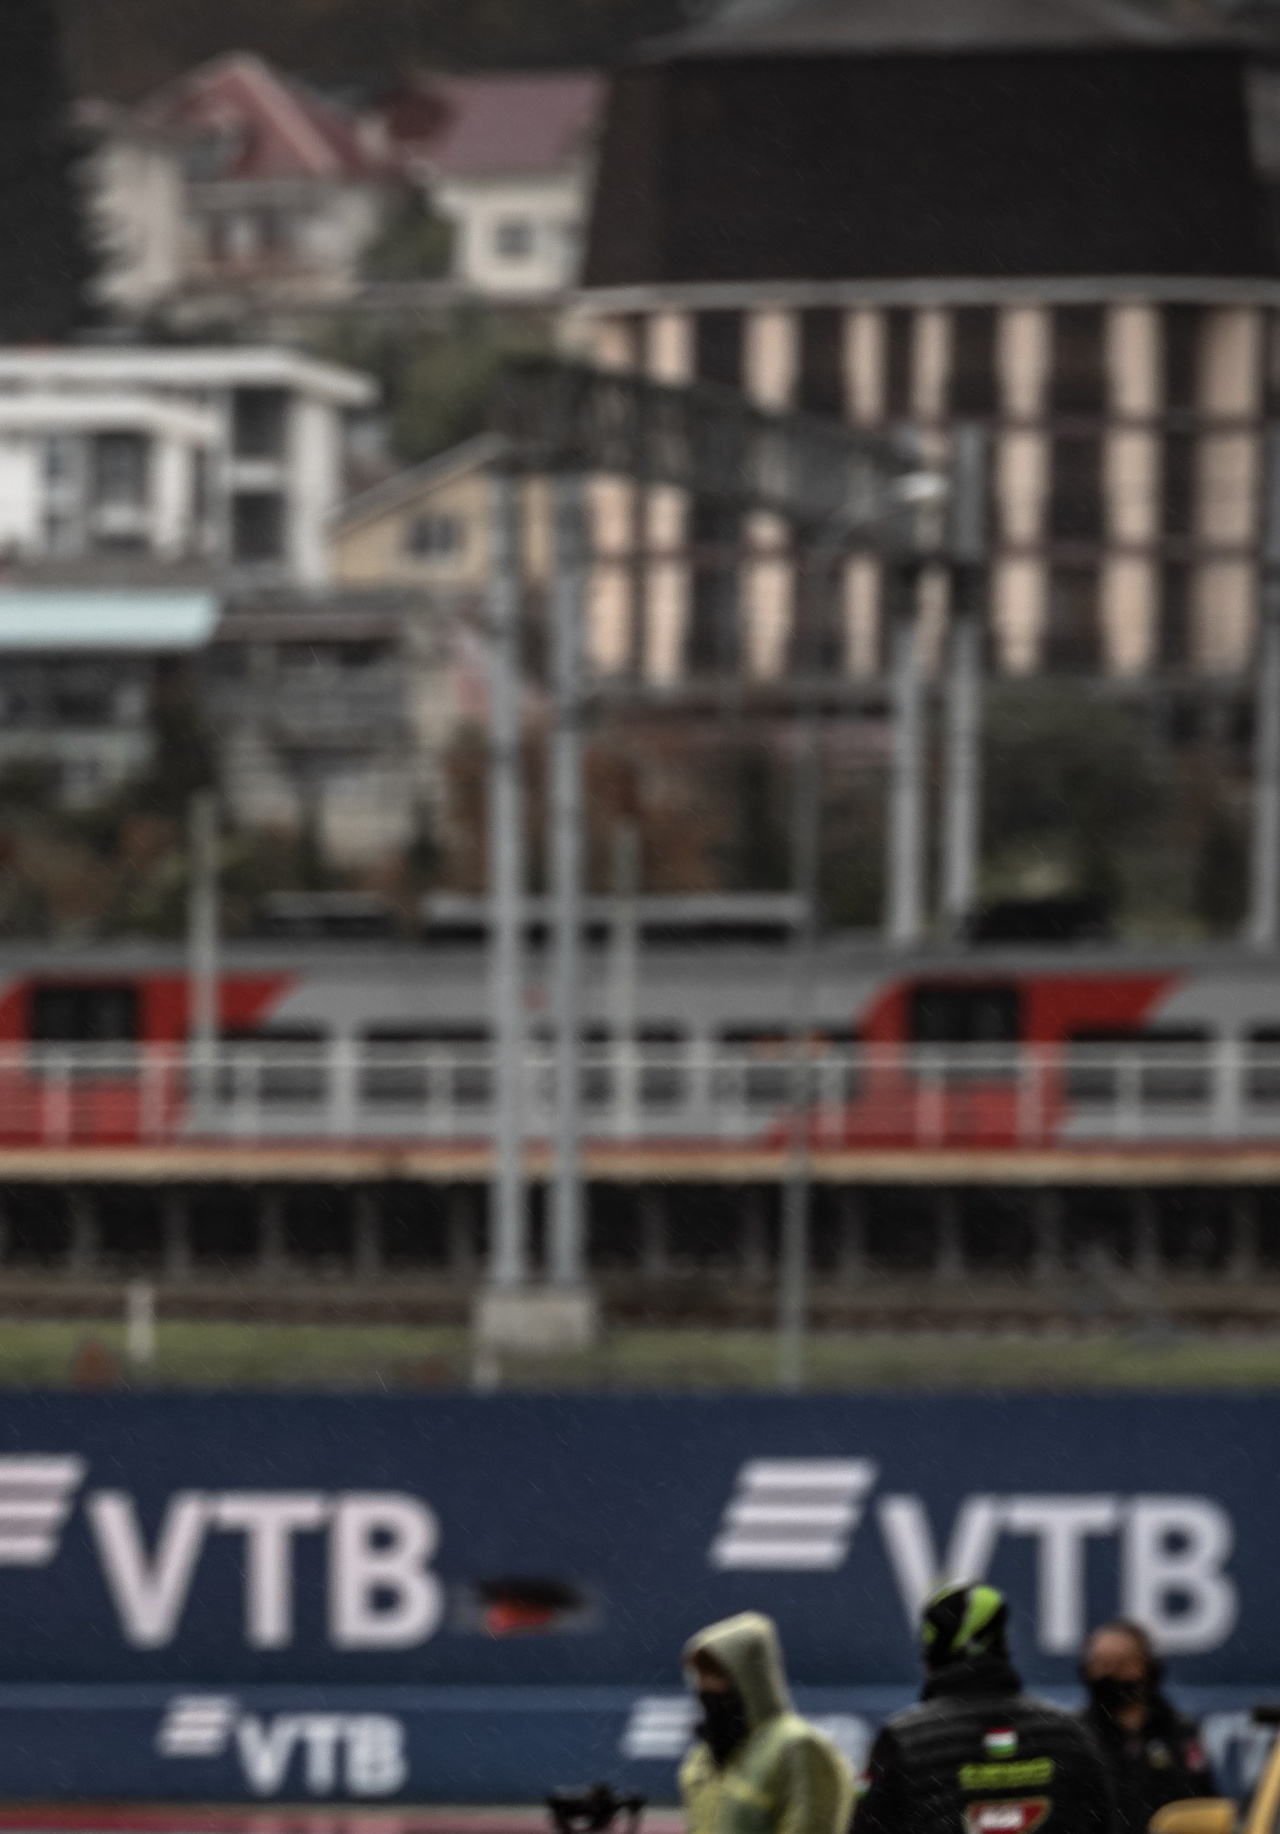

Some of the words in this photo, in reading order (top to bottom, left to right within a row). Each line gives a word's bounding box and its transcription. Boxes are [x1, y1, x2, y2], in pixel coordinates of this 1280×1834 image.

[88, 1491, 444, 1649] VTB
[877, 1494, 1240, 1655] VTB
[234, 1713, 407, 1794] VTB
